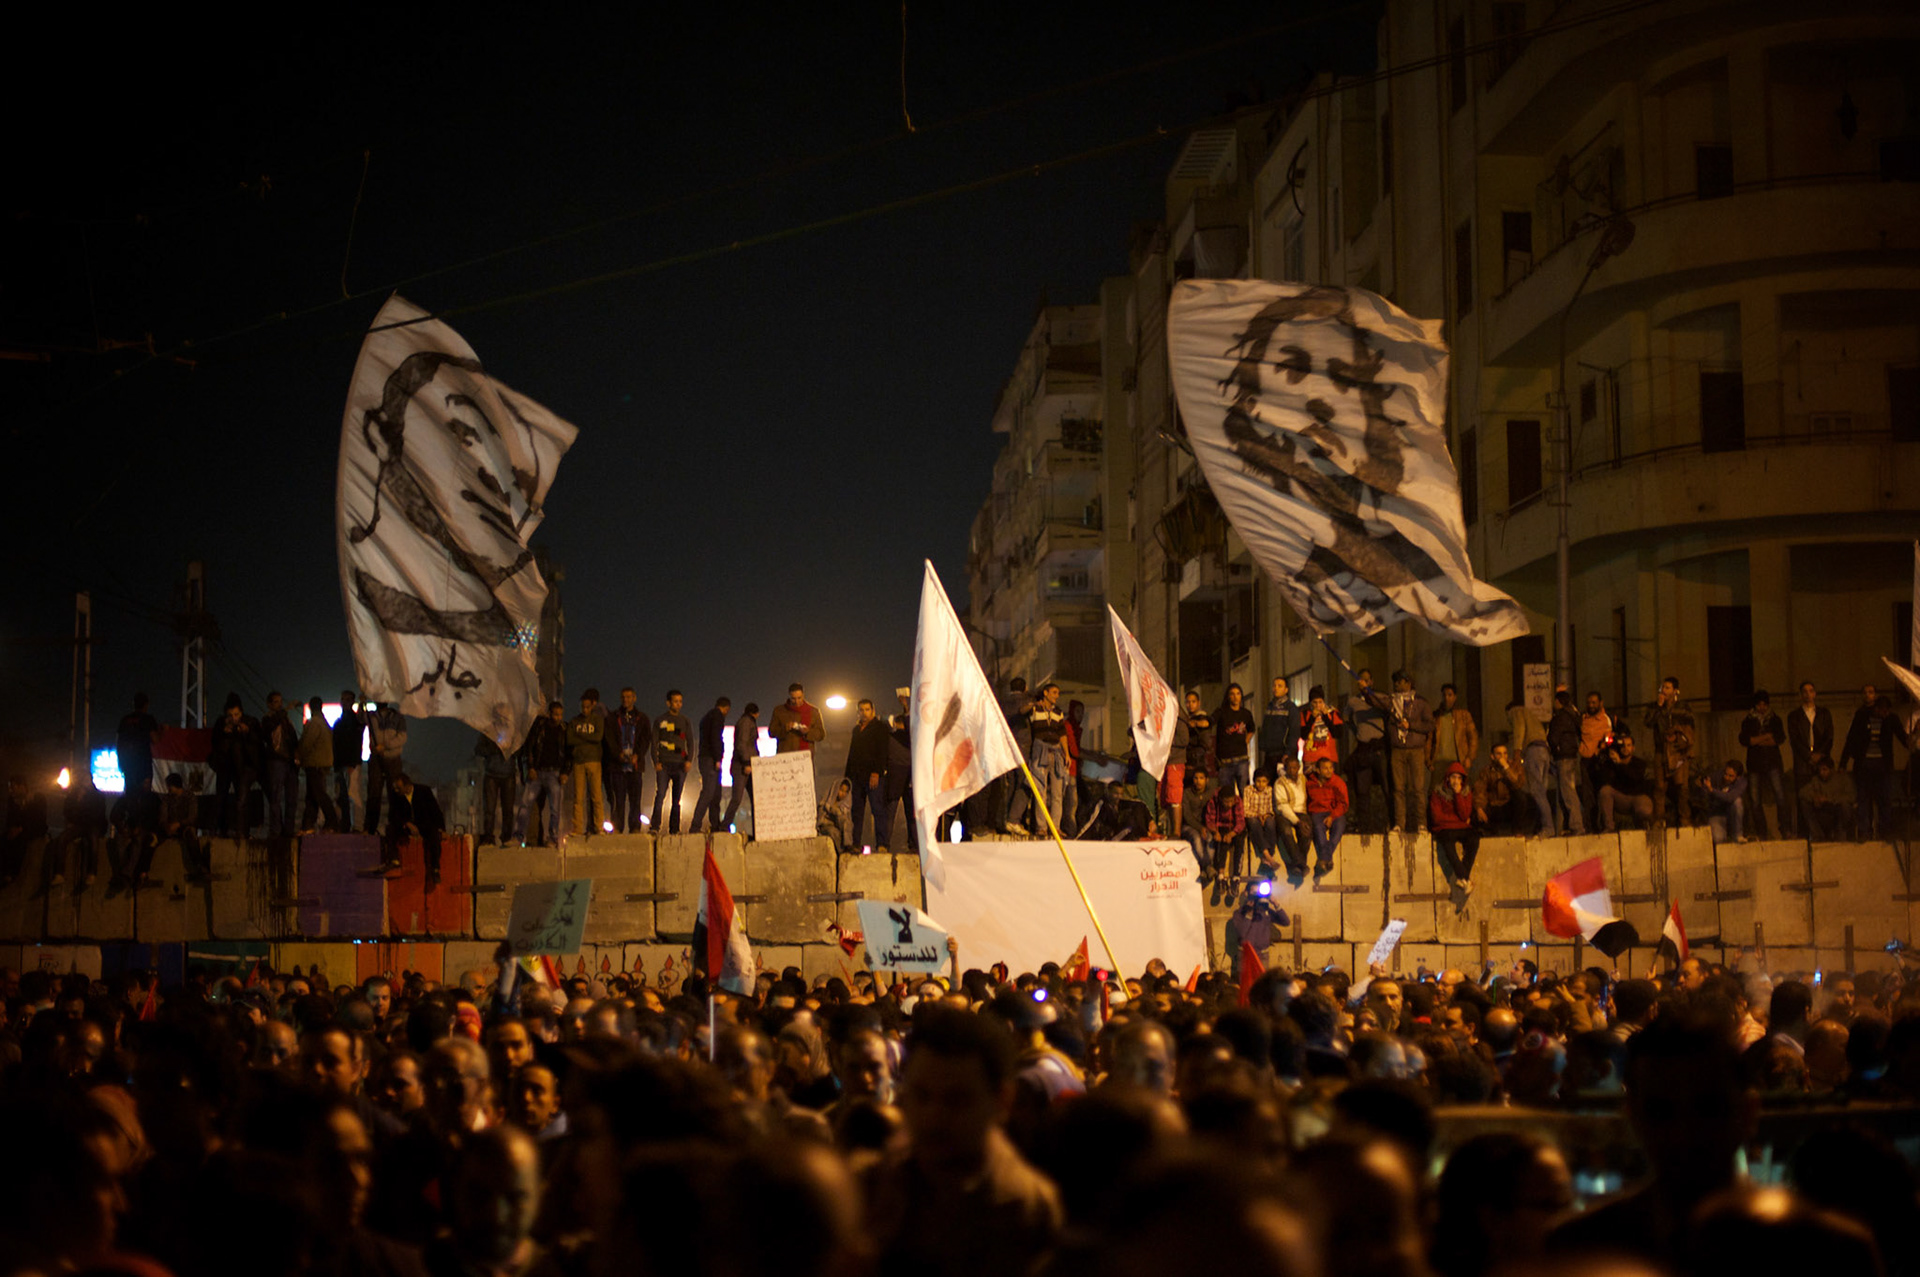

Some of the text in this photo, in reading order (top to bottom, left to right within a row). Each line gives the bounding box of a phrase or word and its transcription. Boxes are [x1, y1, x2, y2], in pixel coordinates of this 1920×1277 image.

[405, 643, 482, 700] جابر
[1140, 868, 1187, 881] المصريين
[563, 883, 577, 905] لا
[888, 907, 913, 943] لا
[881, 945, 938, 967] للدستور
